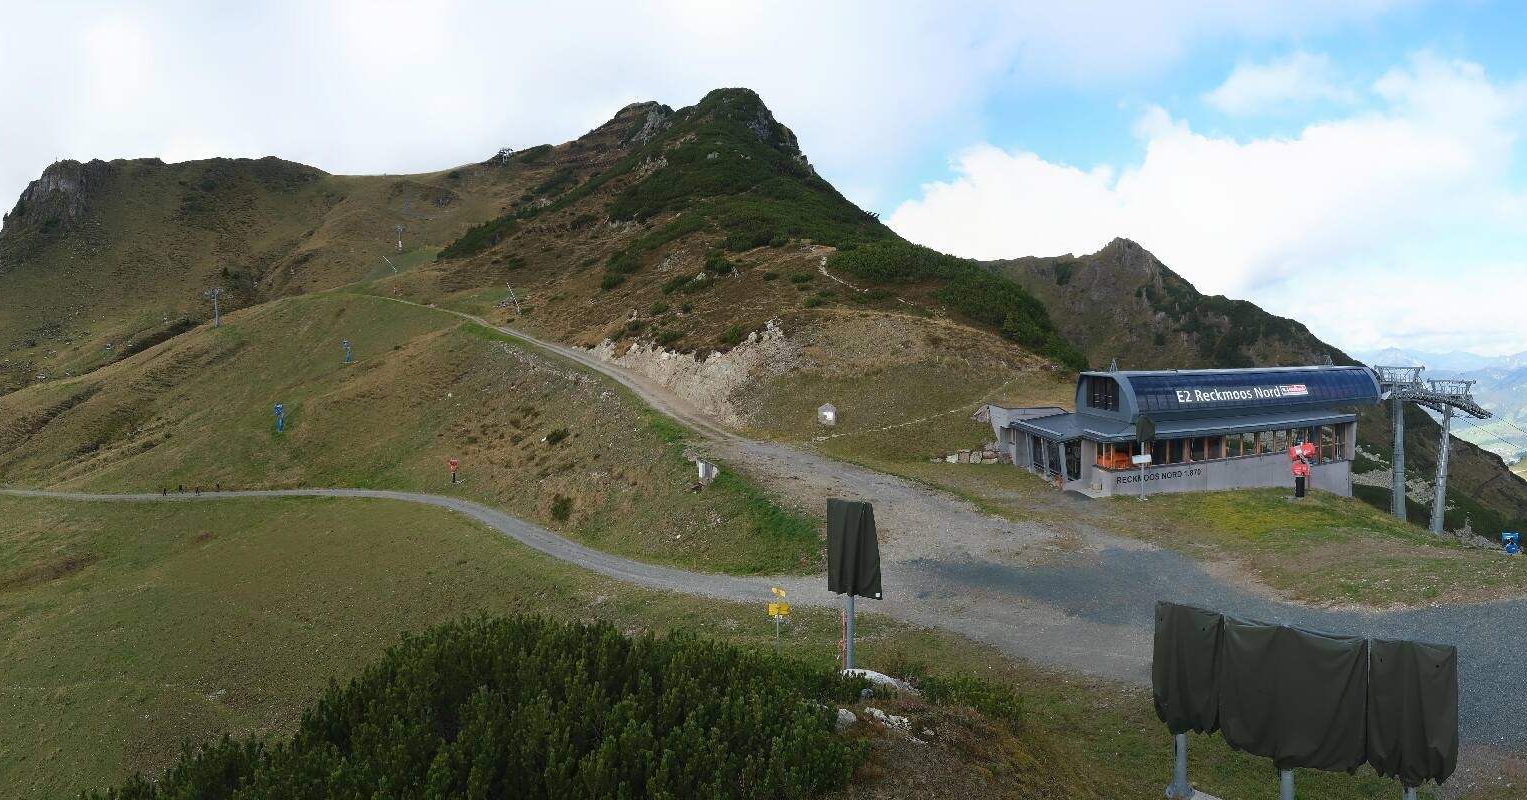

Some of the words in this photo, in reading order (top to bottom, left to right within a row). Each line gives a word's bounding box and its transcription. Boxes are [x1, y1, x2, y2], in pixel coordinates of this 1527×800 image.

[1175, 390, 1193, 403] E2
[1194, 388, 1253, 402] Reckmoos
[1254, 386, 1282, 400] Nord
[1161, 470, 1183, 480] NORD
